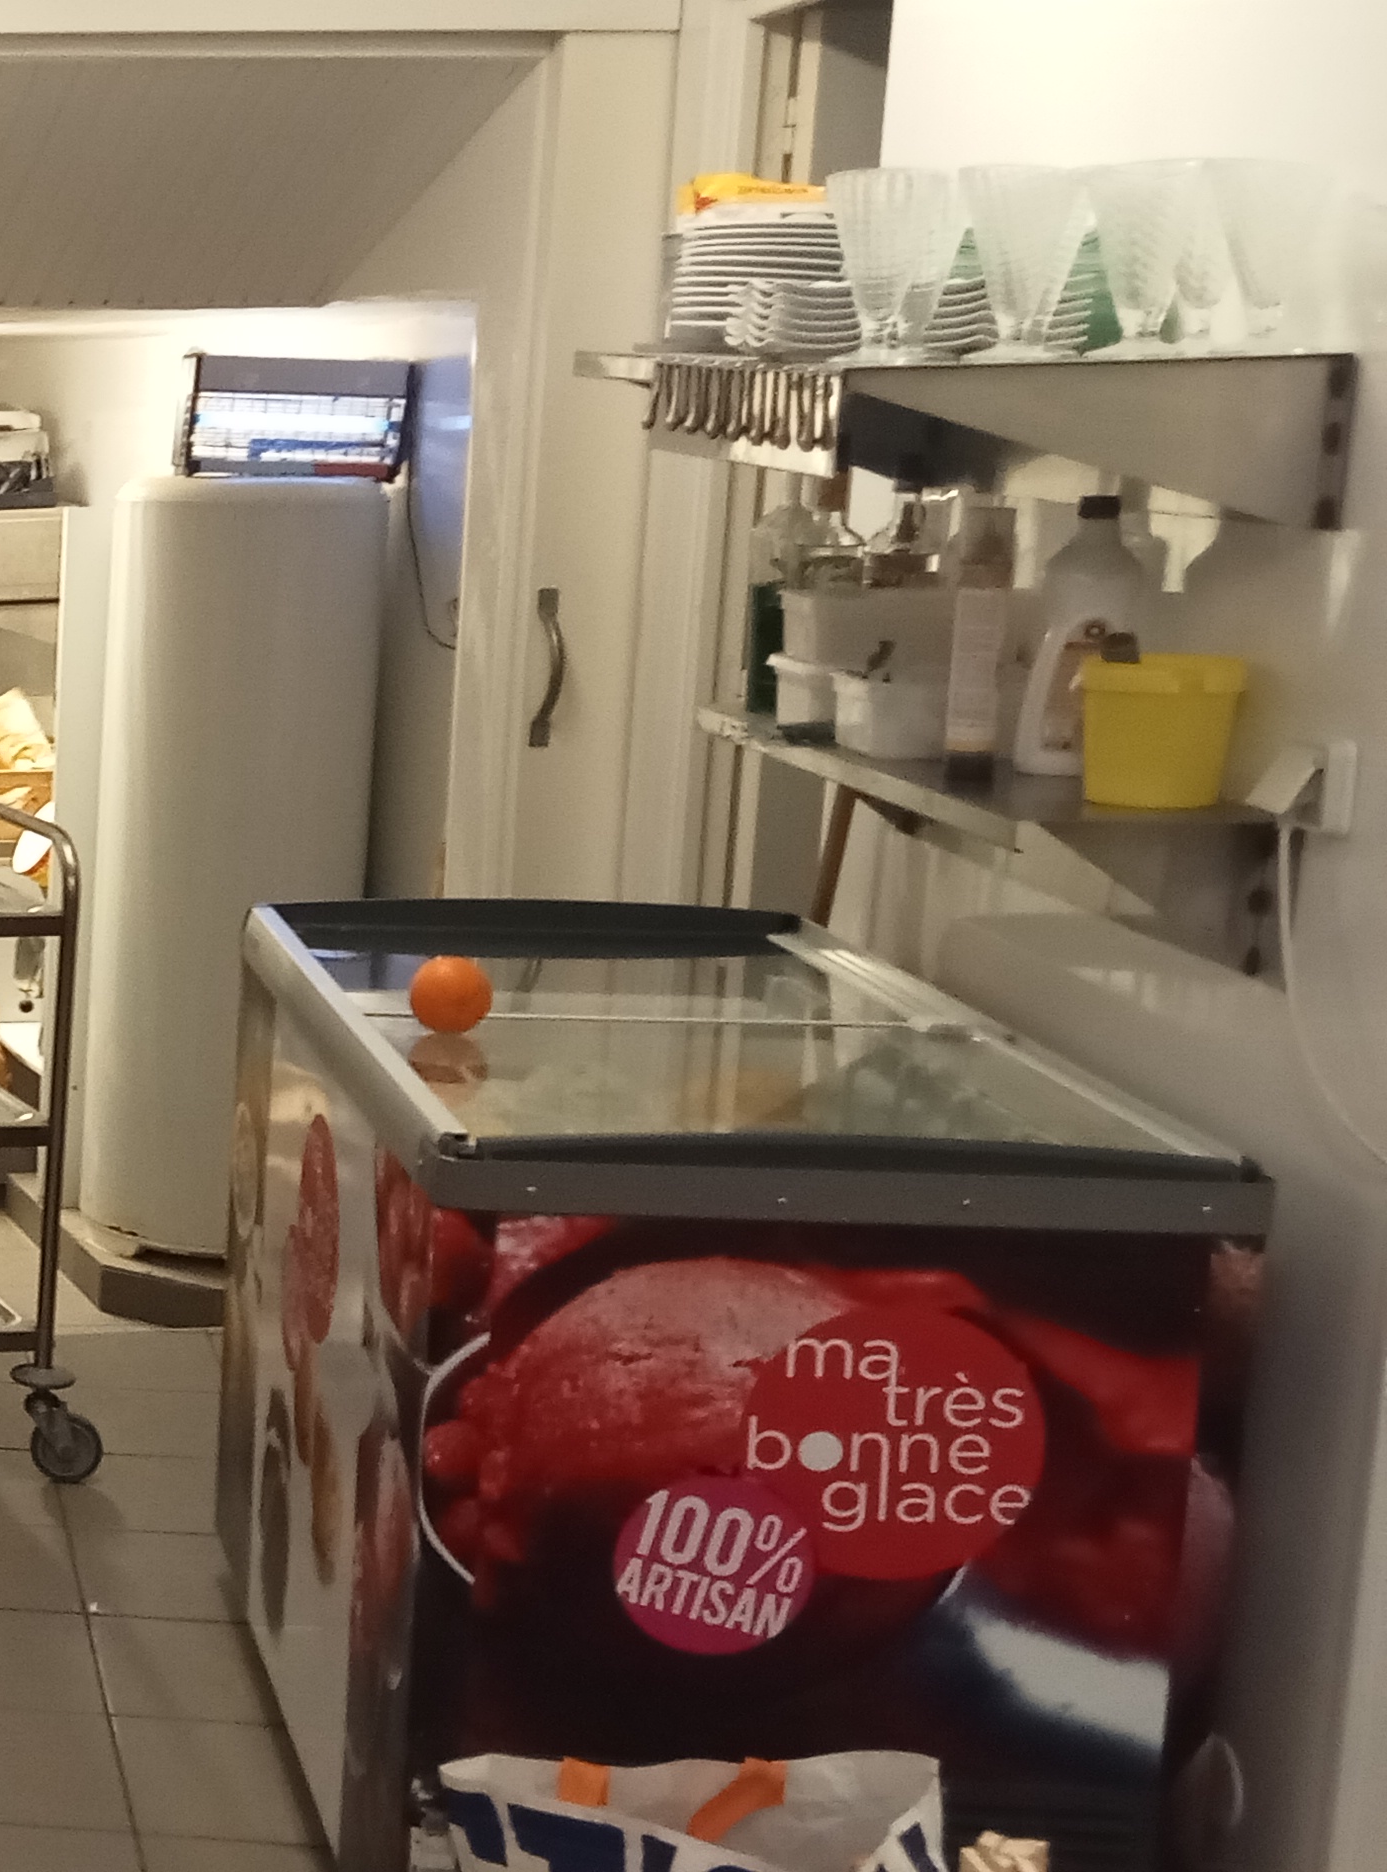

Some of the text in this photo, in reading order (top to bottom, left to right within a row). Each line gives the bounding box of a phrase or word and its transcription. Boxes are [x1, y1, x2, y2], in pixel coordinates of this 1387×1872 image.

[785, 1338, 899, 1380] ma
[882, 1371, 1025, 1428] très
[746, 1415, 992, 1475] bonne
[821, 1480, 1033, 1533] glace
[635, 1488, 807, 1594] 100%
[615, 1556, 793, 1639] ARTISAN
